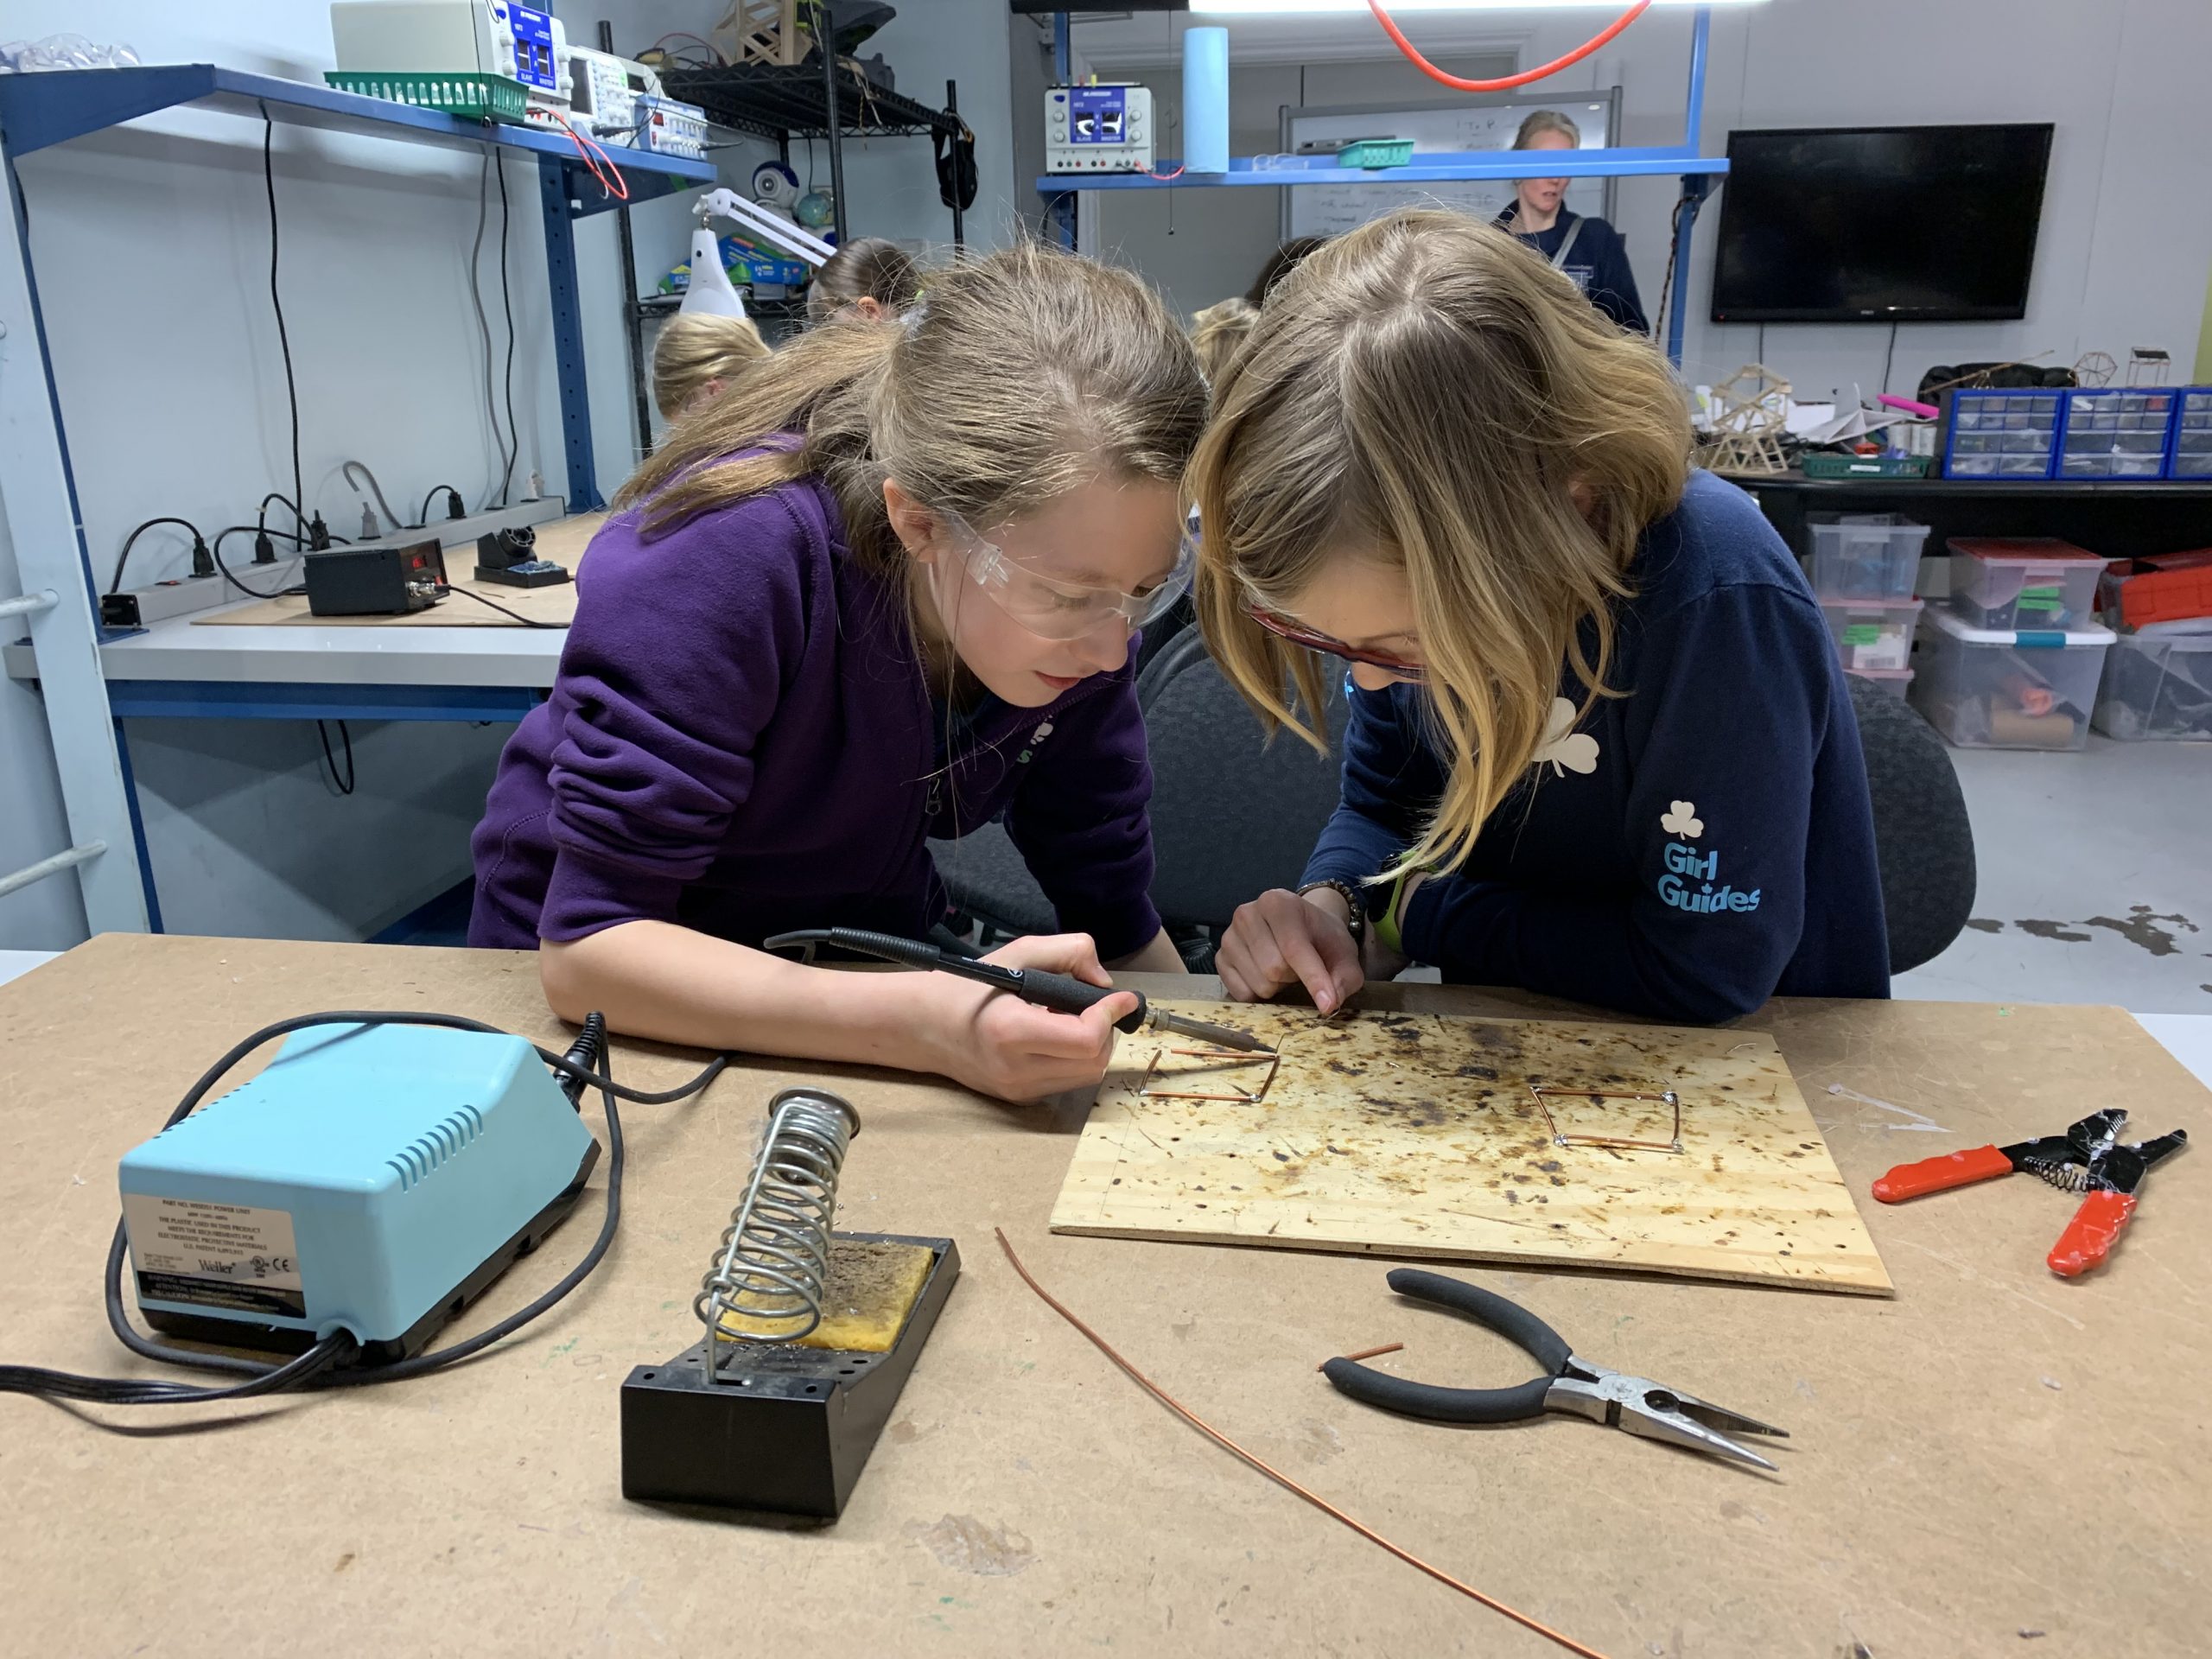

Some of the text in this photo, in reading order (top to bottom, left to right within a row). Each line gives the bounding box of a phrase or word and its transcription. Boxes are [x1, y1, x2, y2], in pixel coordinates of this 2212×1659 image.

[1664, 842, 1719, 880] Girl
[1657, 874, 1761, 914] Guides
[232, 1224, 261, 1233] PRODUCT
[198, 1258, 232, 1274] Weller
